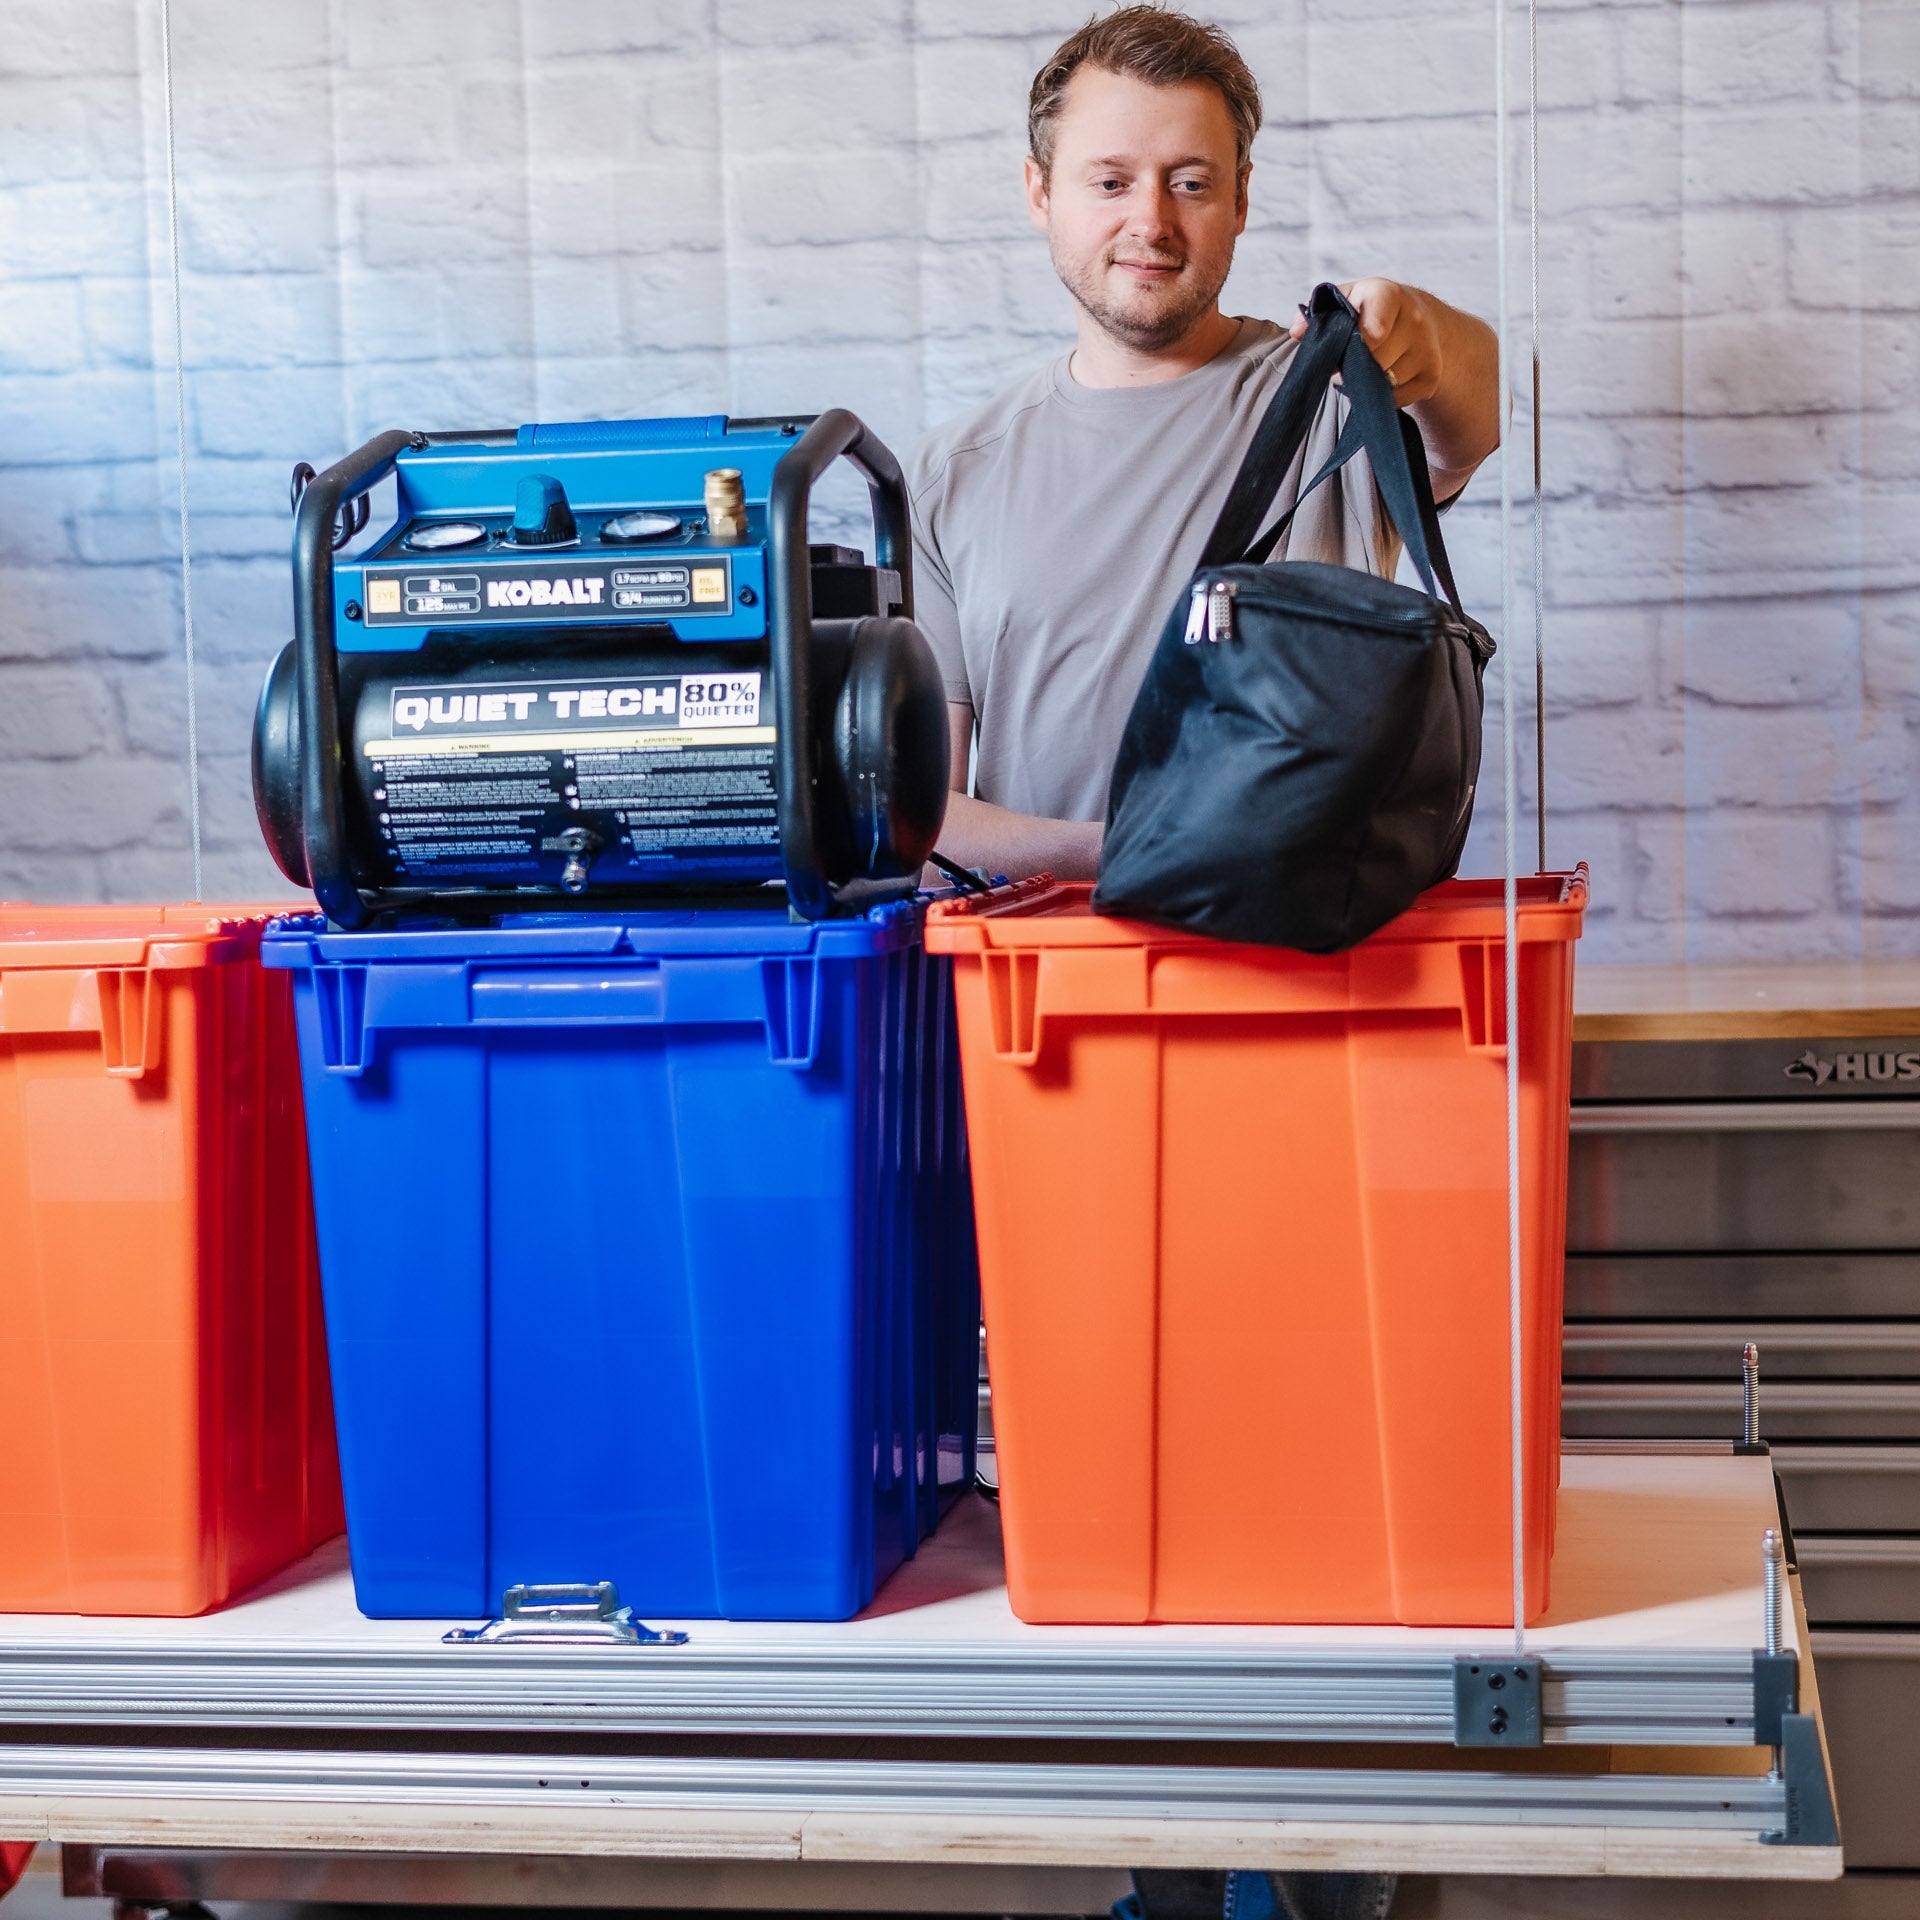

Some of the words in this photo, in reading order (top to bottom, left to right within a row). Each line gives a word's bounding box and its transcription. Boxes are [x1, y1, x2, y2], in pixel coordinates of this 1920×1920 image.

[428, 579, 440, 593] 2
[487, 578, 604, 607] KOBALT
[416, 597, 444, 612] 125
[685, 682, 755, 703] 80%
[394, 692, 538, 732] QUIET
[548, 686, 677, 718] TECH
[684, 705, 755, 718] QUIETER
[1836, 1053, 1920, 1081] HUS
